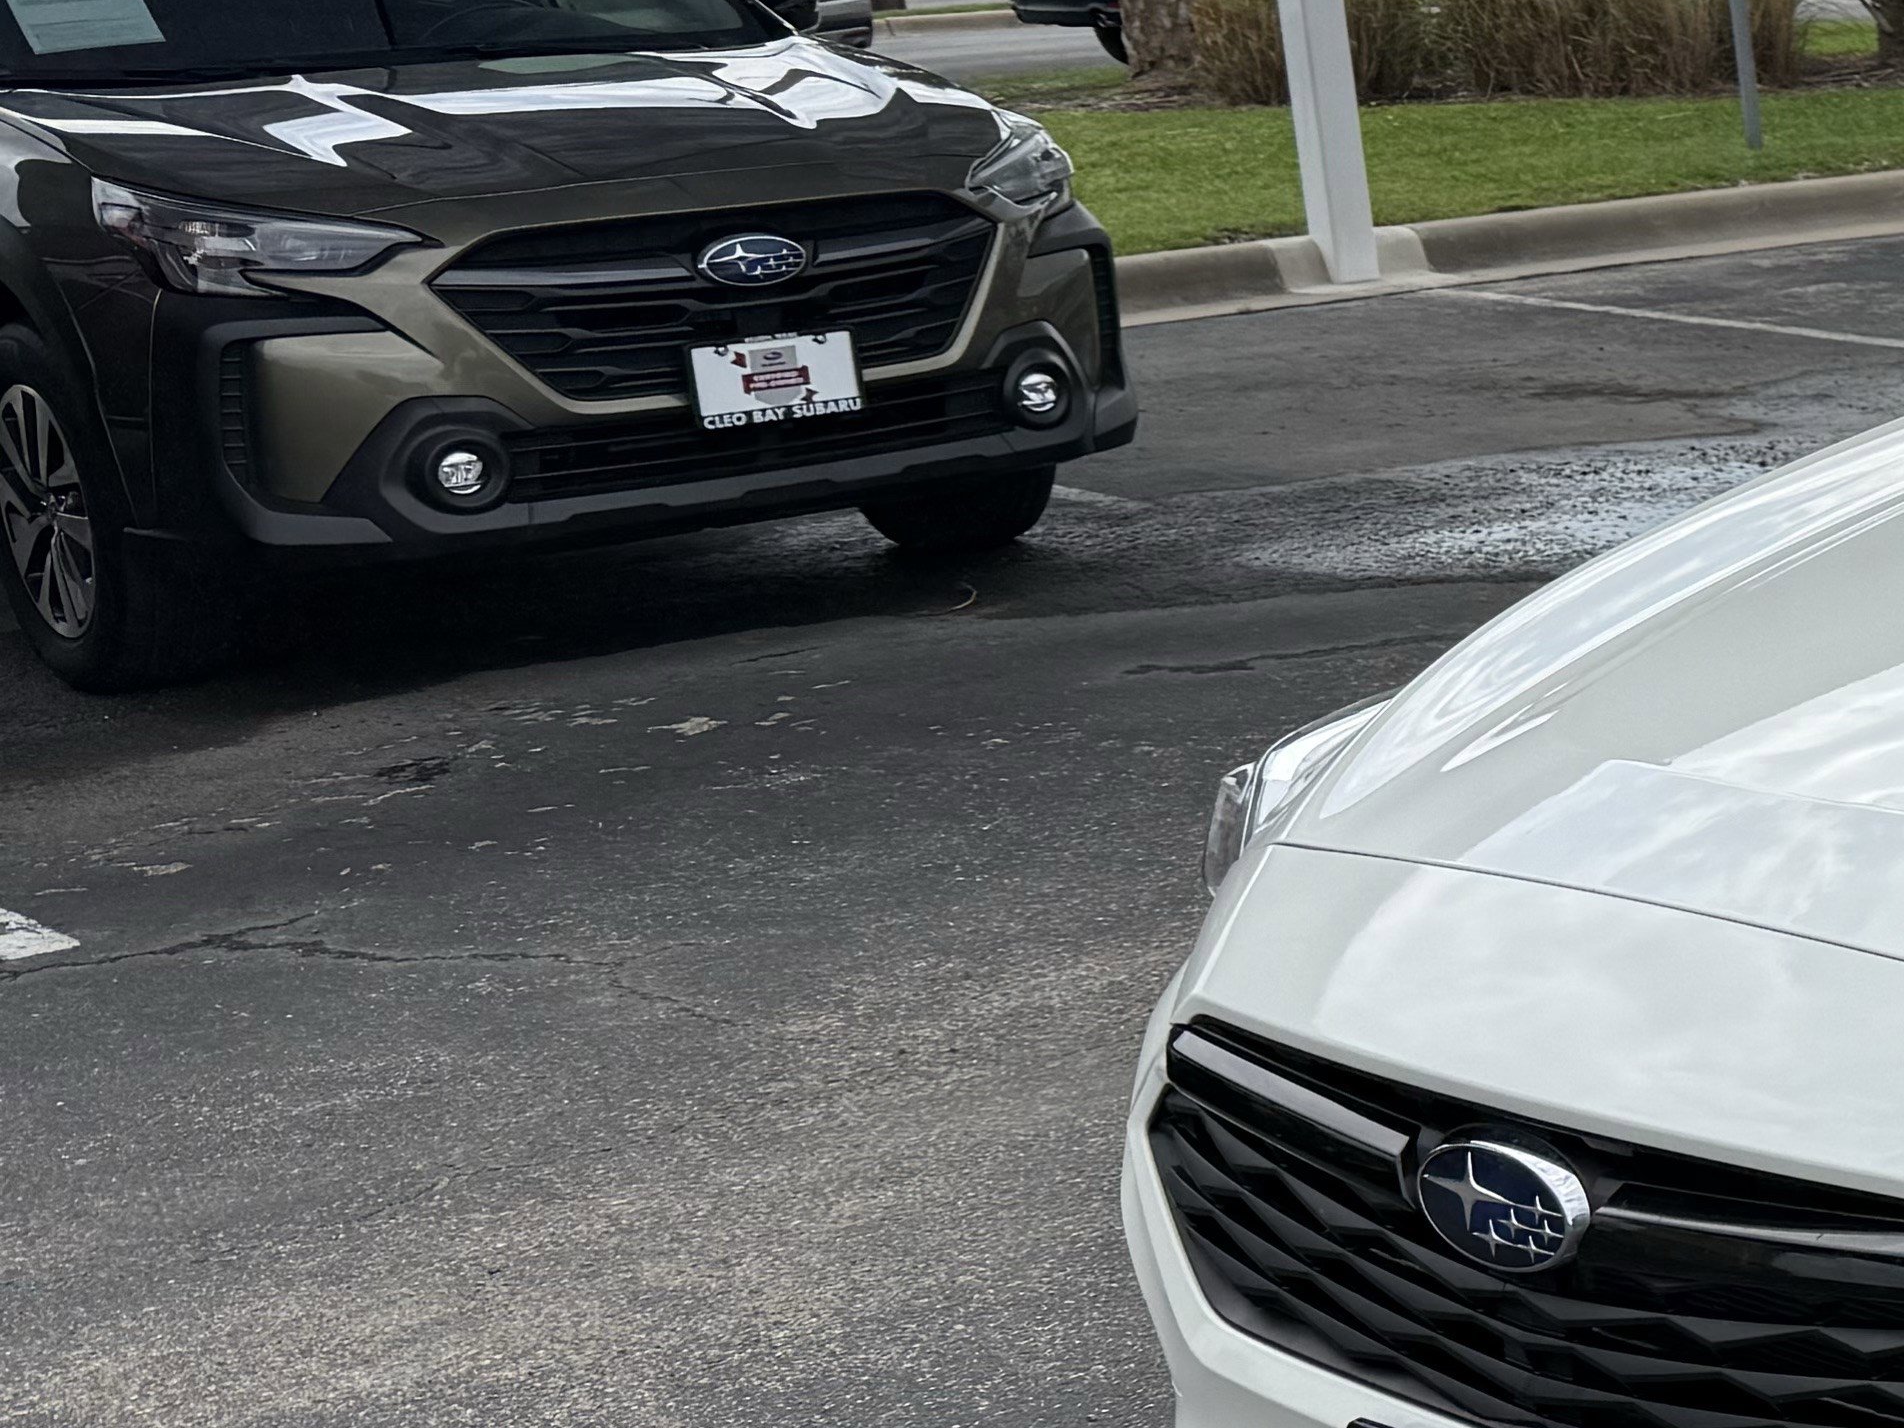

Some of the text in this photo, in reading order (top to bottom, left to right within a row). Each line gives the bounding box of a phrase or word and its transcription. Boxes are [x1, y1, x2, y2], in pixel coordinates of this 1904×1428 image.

[703, 398, 862, 430] CLEO BAY SUBARU
